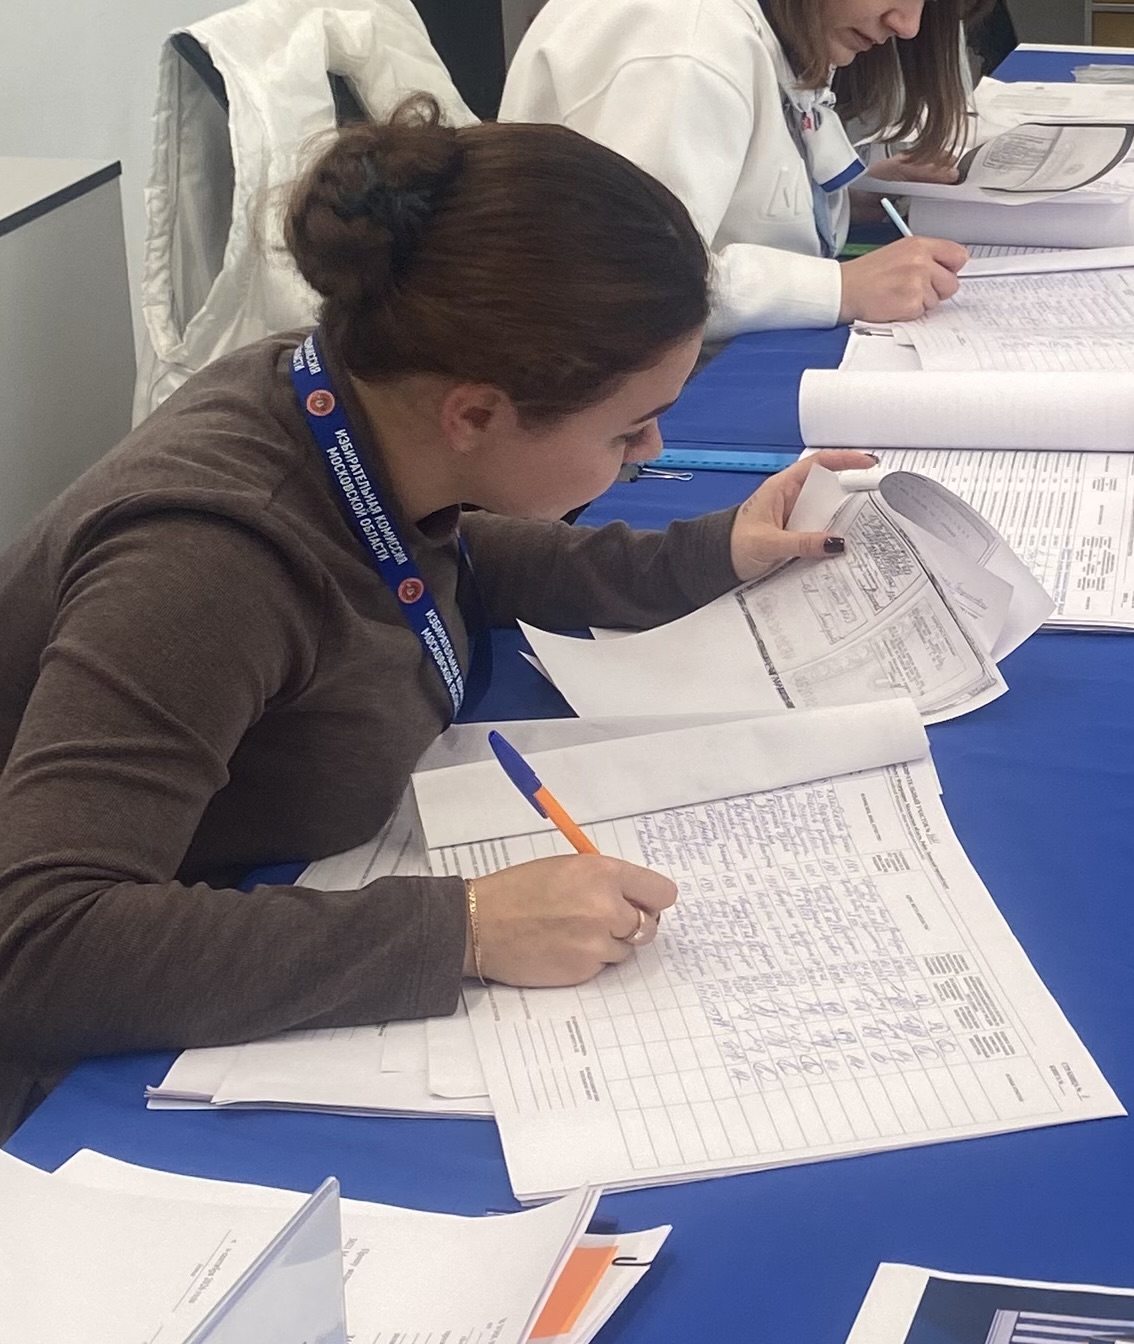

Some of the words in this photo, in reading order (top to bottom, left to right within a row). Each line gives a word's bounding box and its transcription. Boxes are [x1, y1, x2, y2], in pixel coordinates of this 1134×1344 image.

[326, 447, 367, 517] МОСКОВСКОЙ
[360, 515, 388, 562] ОБЛАСТИ
[334, 429, 379, 516] ИЗБИРАТЕЛЬНАЯ
[374, 511, 408, 566] КОМИССИЯ
